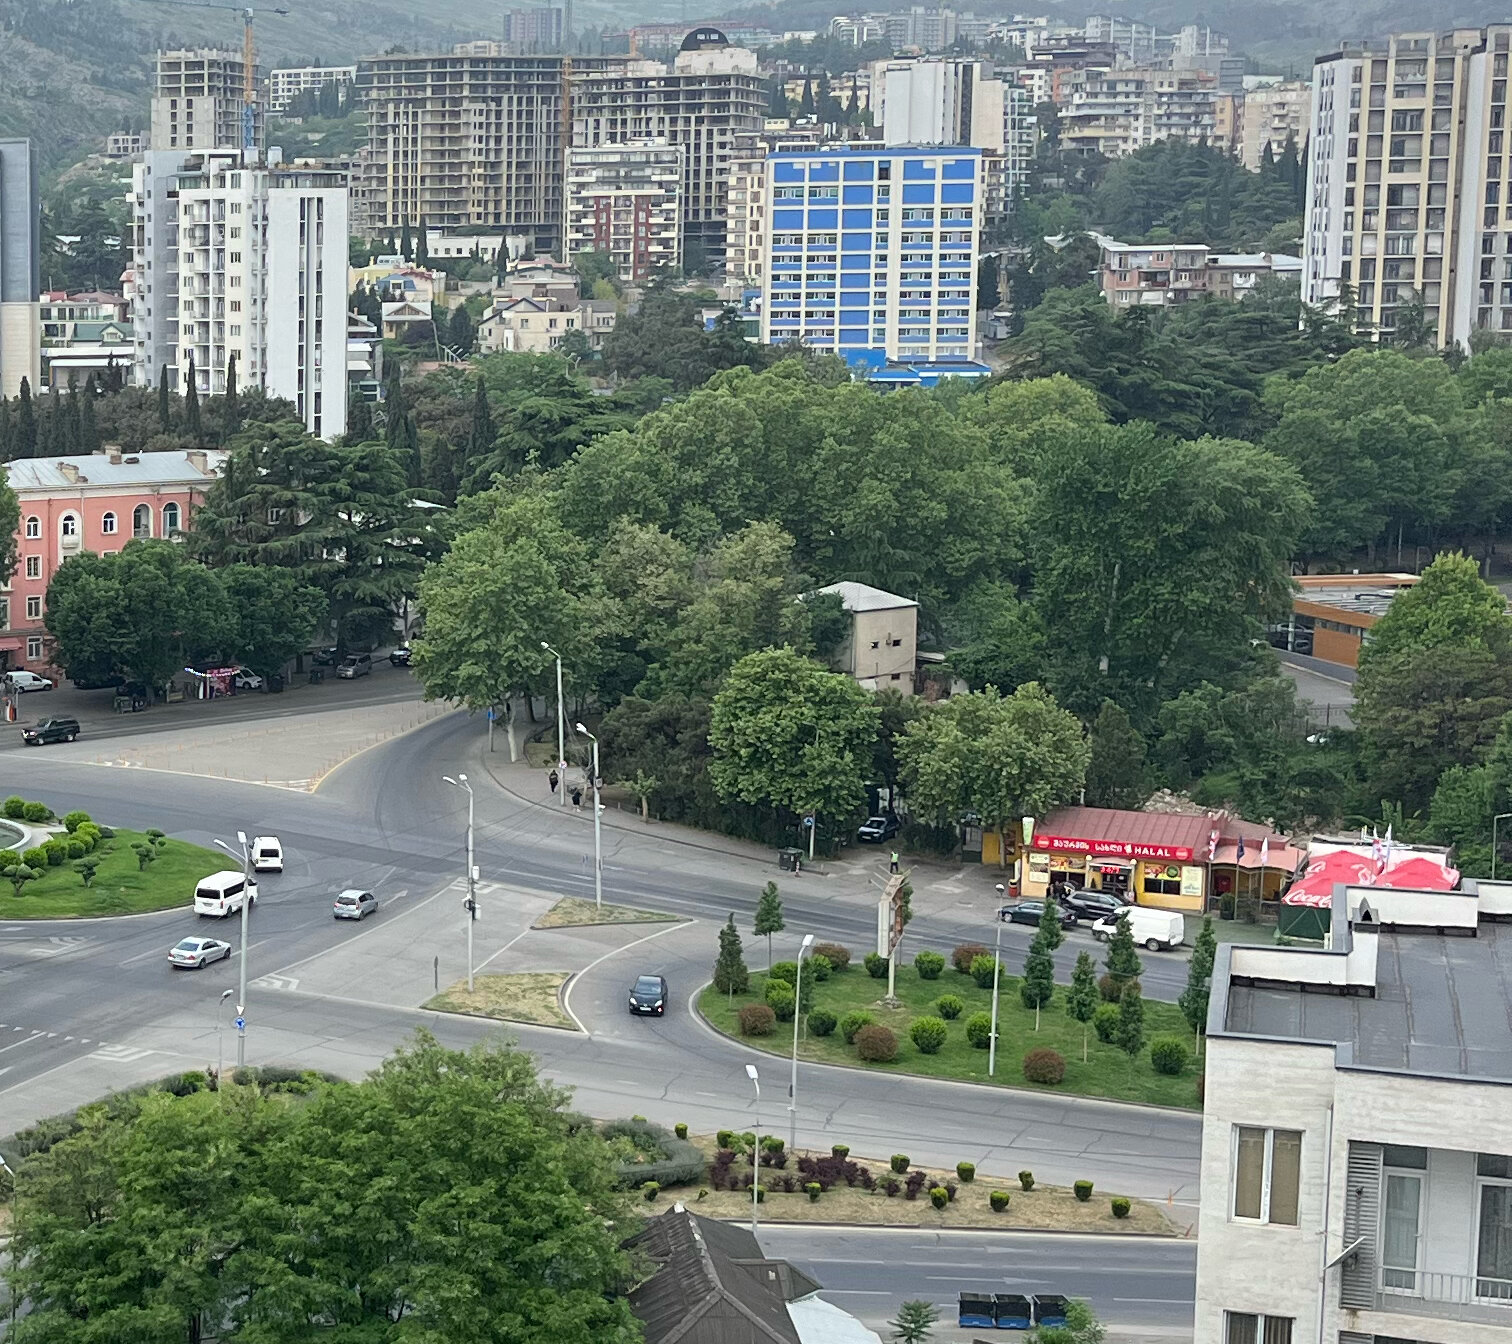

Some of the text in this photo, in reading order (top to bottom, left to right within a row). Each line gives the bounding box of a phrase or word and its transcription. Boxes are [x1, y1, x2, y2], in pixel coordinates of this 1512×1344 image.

[1053, 839, 1089, 850] შაურმის
[1095, 843, 1122, 853] სახლი
[1134, 846, 1171, 857] HALAL
